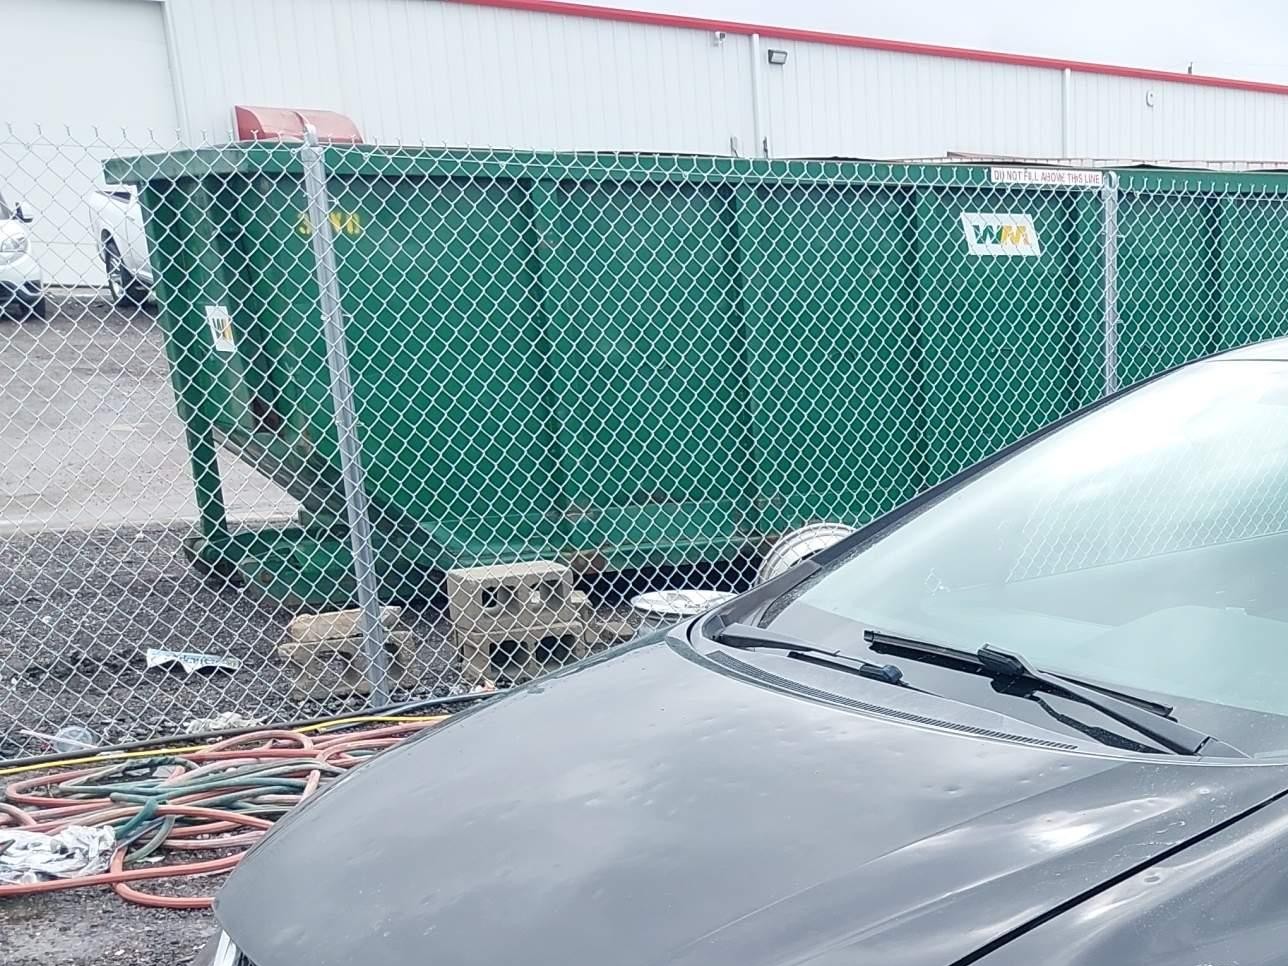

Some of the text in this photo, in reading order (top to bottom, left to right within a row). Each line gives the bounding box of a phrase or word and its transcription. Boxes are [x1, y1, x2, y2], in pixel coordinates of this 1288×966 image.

[1007, 170, 1023, 181] NOT
[1067, 173, 1083, 184] THIS
[1084, 173, 1100, 184] LINE
